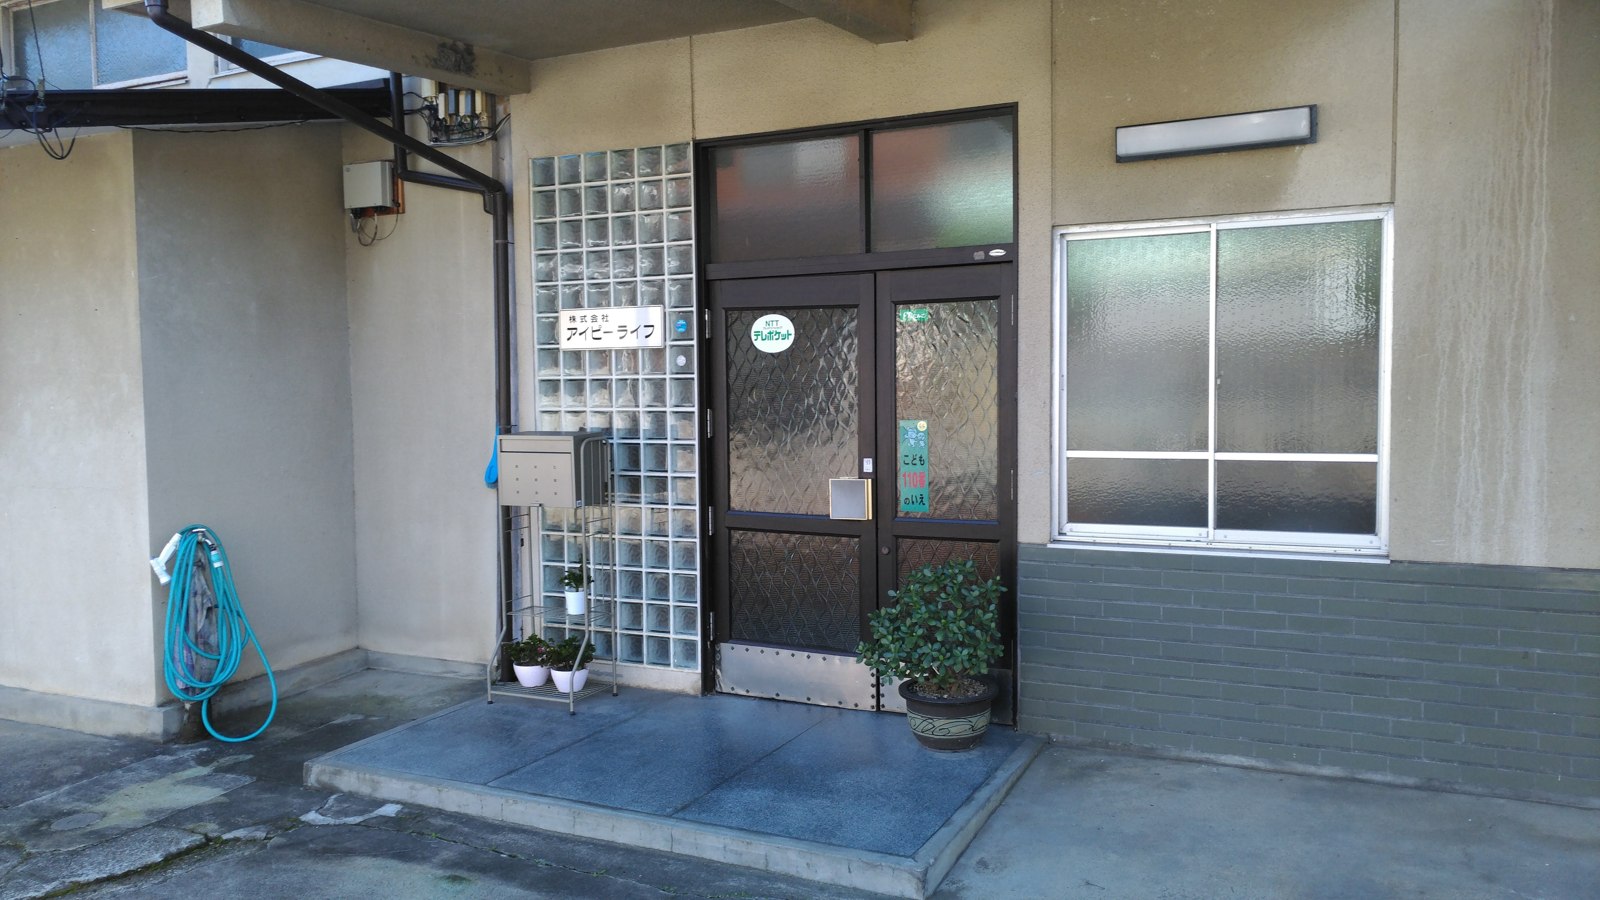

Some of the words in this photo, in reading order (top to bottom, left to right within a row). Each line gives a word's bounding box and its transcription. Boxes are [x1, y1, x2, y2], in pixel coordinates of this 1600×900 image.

[569, 314, 609, 323] 株式会社
[567, 325, 654, 341] アイピーライフ
[754, 329, 792, 341] テレポケット
[904, 454, 925, 465] こども
[903, 472, 926, 488] 110番
[905, 494, 926, 505] のいえ
